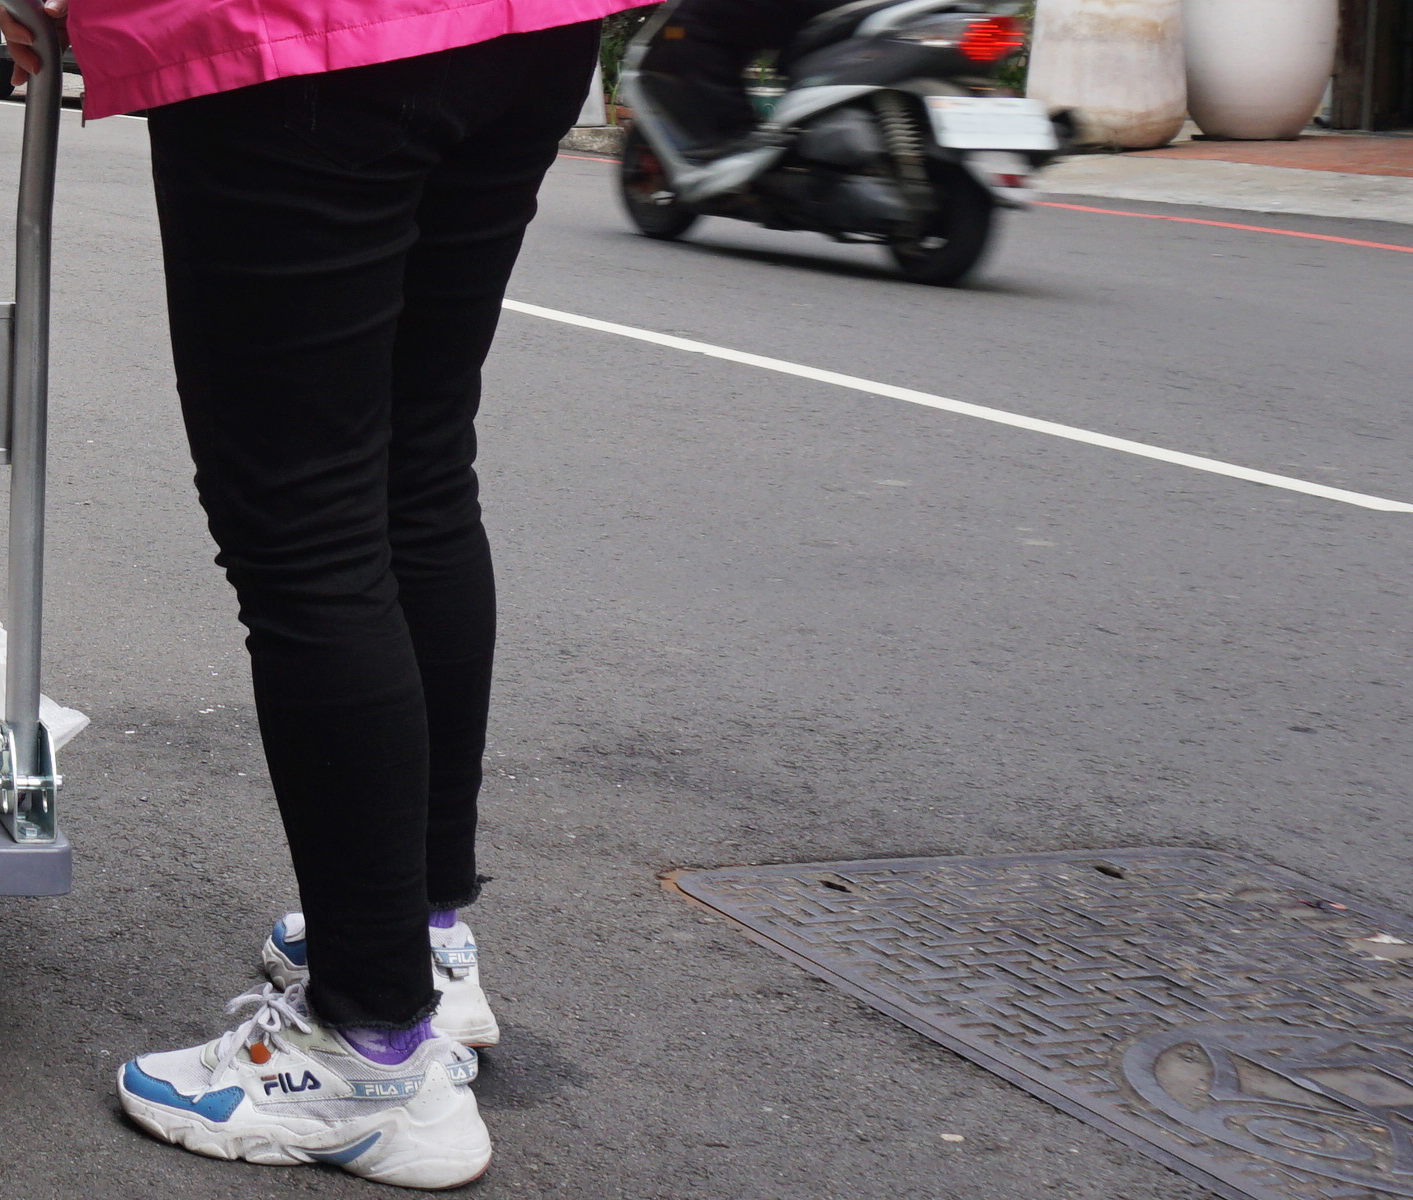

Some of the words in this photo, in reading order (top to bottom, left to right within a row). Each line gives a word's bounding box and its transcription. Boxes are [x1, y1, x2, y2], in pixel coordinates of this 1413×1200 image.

[448, 952, 476, 963] FILA
[260, 1069, 322, 1097] FILA
[364, 1084, 399, 1097] FILA
